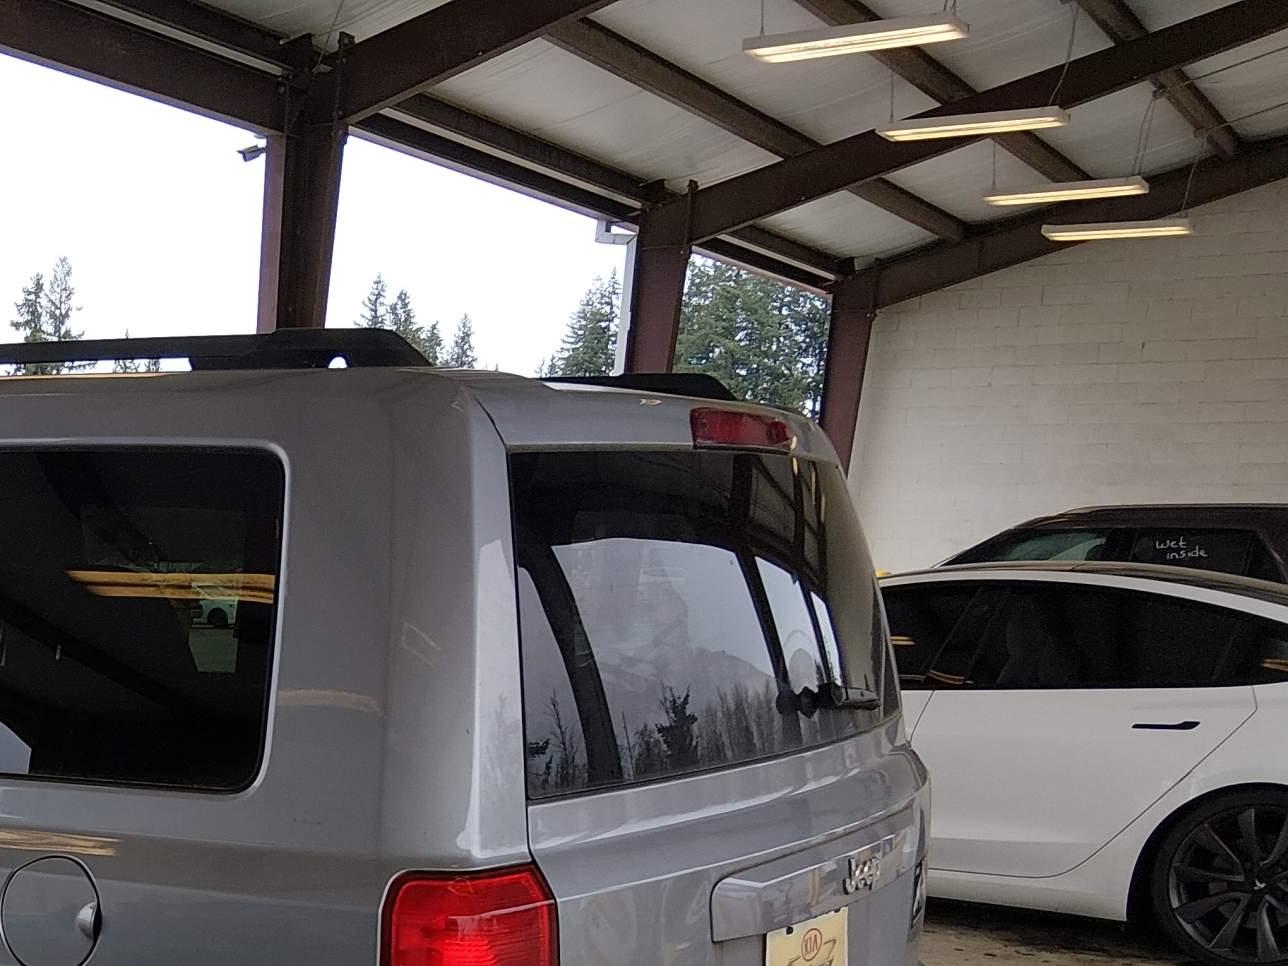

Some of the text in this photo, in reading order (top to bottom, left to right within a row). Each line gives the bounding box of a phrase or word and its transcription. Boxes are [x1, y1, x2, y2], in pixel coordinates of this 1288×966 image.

[1166, 545, 1209, 560] inside
[843, 857, 880, 895] Jeep
[803, 933, 820, 956] KIA
